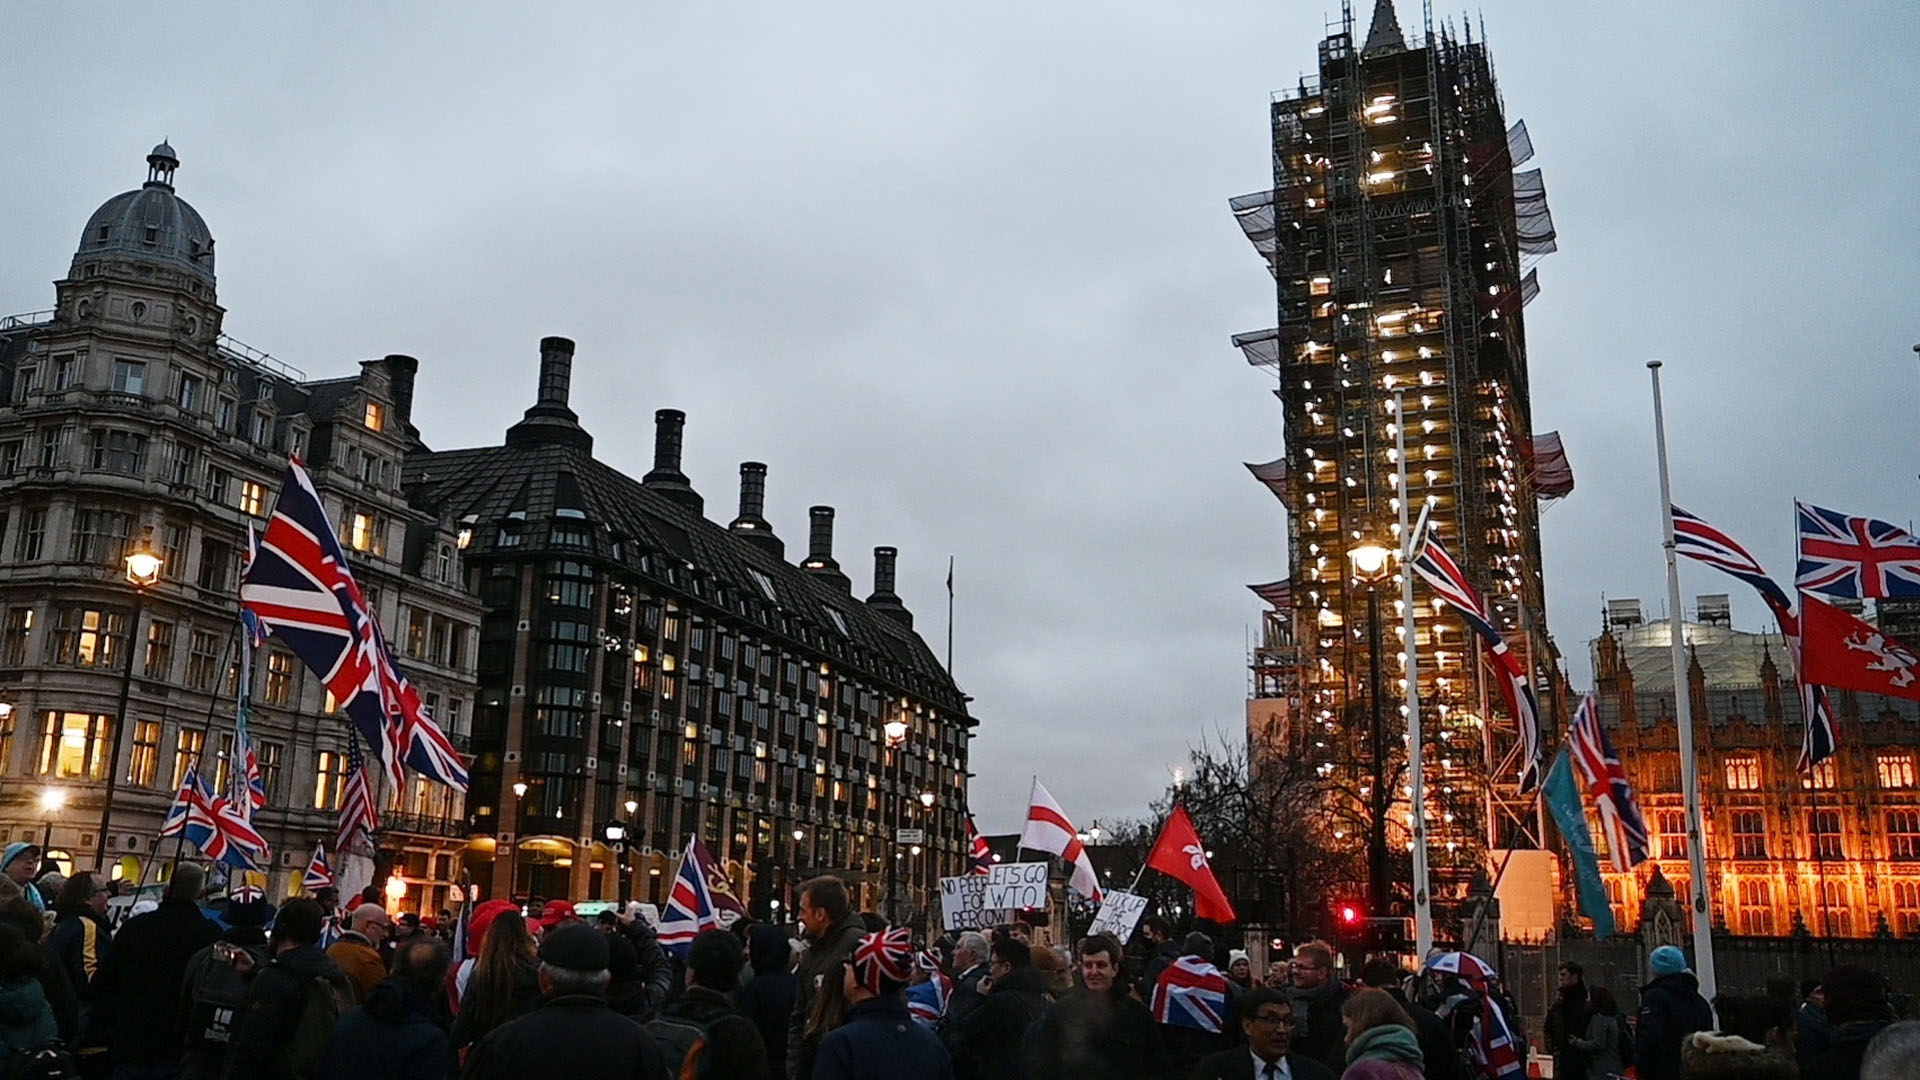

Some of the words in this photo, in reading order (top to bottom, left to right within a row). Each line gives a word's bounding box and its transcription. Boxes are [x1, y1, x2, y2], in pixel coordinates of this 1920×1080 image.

[1024, 865, 1047, 884] GO
[941, 879, 956, 895] NO
[990, 885, 1037, 907] WTO
[1128, 899, 1146, 913] UP
[952, 909, 1006, 929] BERCOW
